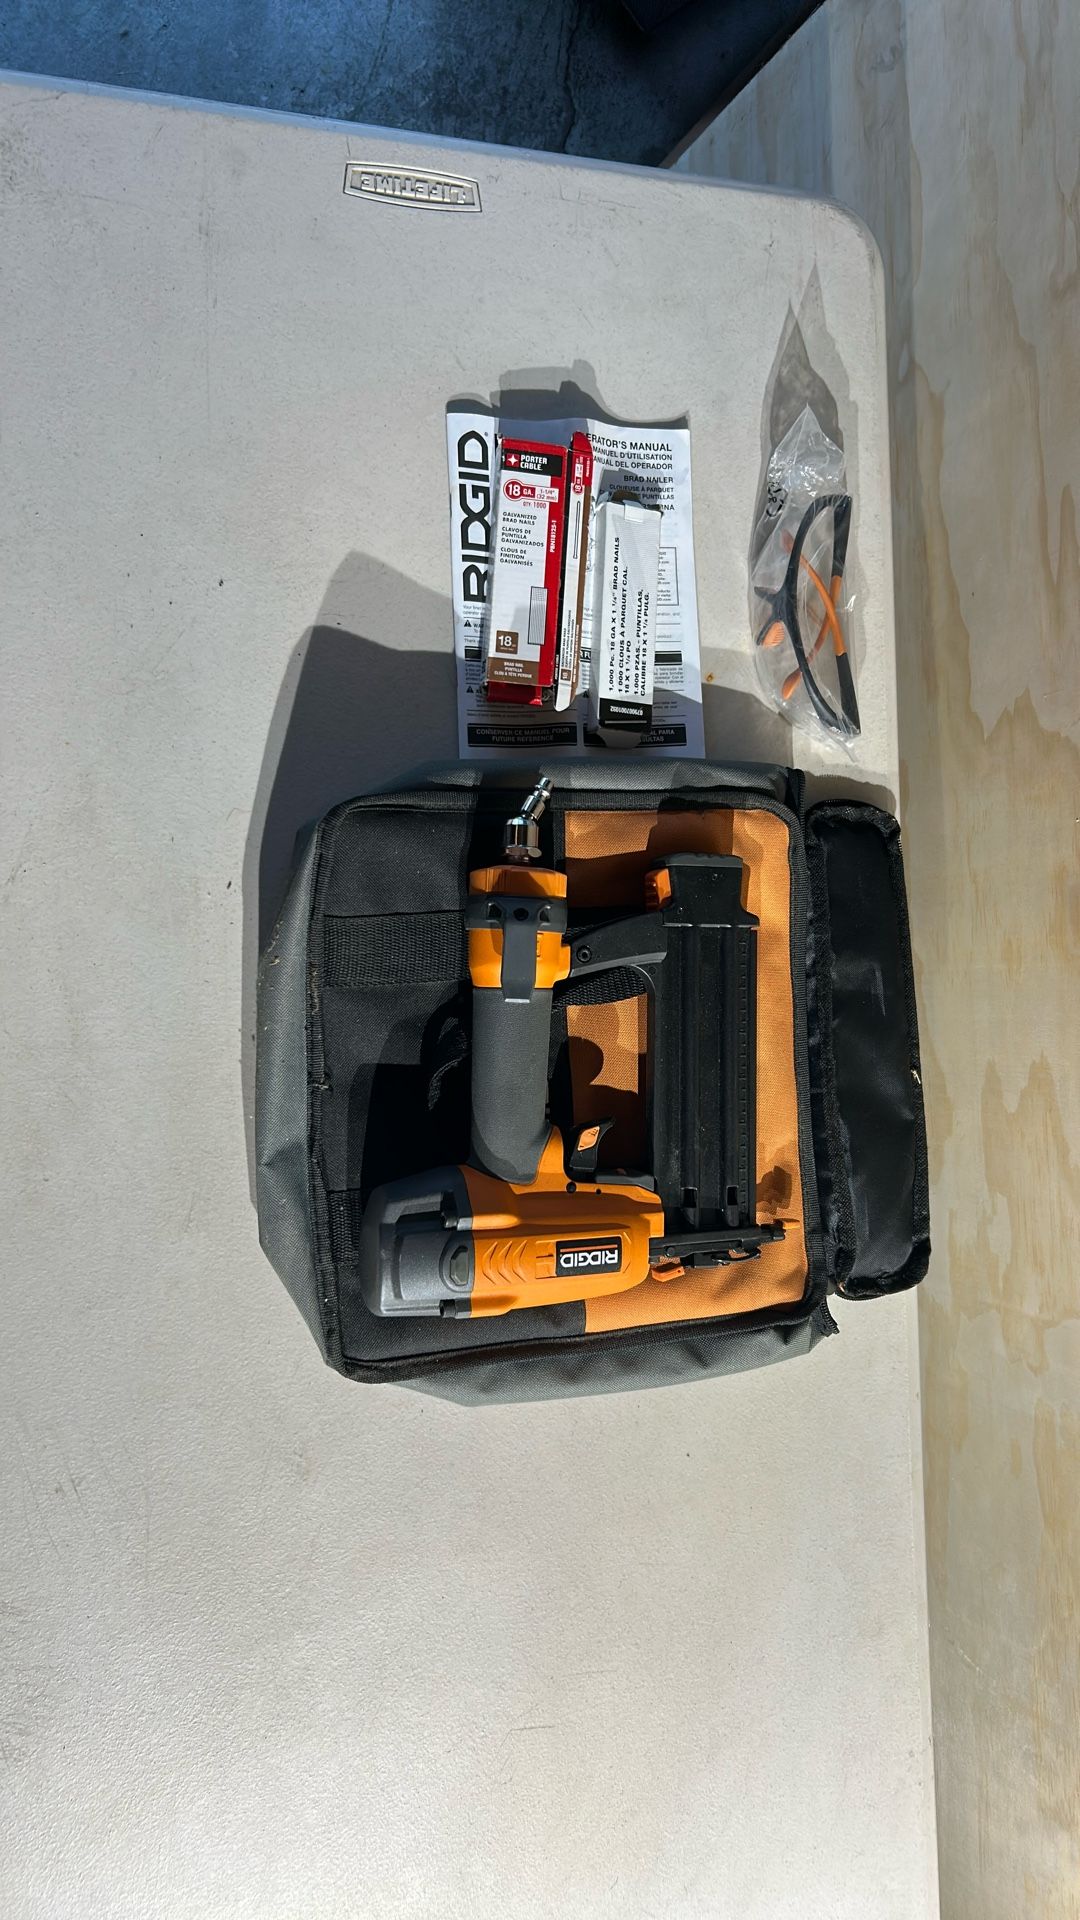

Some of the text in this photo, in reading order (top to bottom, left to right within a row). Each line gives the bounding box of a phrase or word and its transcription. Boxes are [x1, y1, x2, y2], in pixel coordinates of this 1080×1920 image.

[361, 172, 466, 203] LIFETIME
[586, 433, 673, 451] ERATOR'S MANUAL
[592, 445, 673, 461] MANUEL D'UTILISATION
[520, 454, 548, 465] PORTER
[593, 456, 614, 467] ANUAL
[615, 460, 629, 469] DEL
[631, 462, 673, 470] OPERADOR
[520, 461, 543, 471] CABLE
[646, 476, 674, 484] NAILER
[508, 484, 521, 497] 18
[457, 430, 491, 603] RIDGID
[502, 511, 537, 520] GALVANIZED
[501, 526, 523, 534] CLAVOS
[501, 532, 527, 540] PUNTILLA
[501, 537, 544, 547] GALVANIZADOS
[500, 552, 525, 560] FINITION
[499, 558, 533, 567] GALVANISÉS
[610, 626, 616, 639] GA
[498, 635, 512, 647] 18
[610, 641, 615, 651] 18
[626, 640, 631, 653] PO
[642, 647, 647, 657] 18
[625, 684, 630, 693] 18
[560, 1249, 618, 1268] RIDGID
